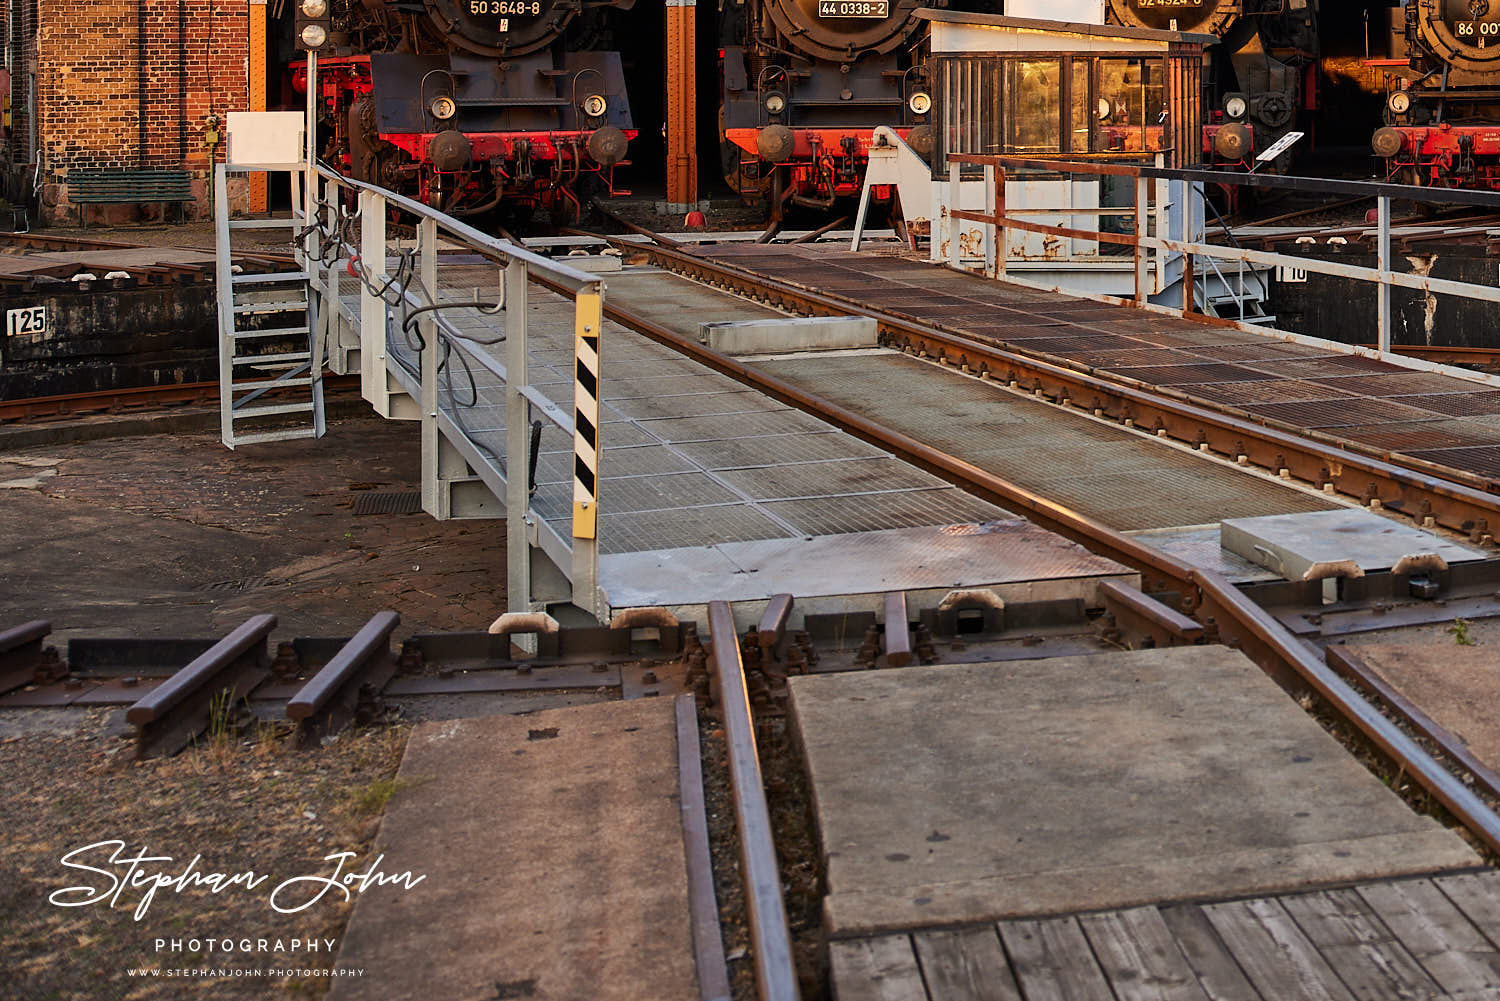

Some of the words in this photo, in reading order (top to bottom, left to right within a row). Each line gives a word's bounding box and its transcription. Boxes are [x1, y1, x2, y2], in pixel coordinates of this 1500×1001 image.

[470, 1, 488, 14] 50
[491, 1, 540, 15] 3648-8
[822, 3, 837, 14] 44
[840, 3, 885, 15] 0338-2
[1458, 22, 1474, 35] 86
[20, 309, 44, 333] 25
